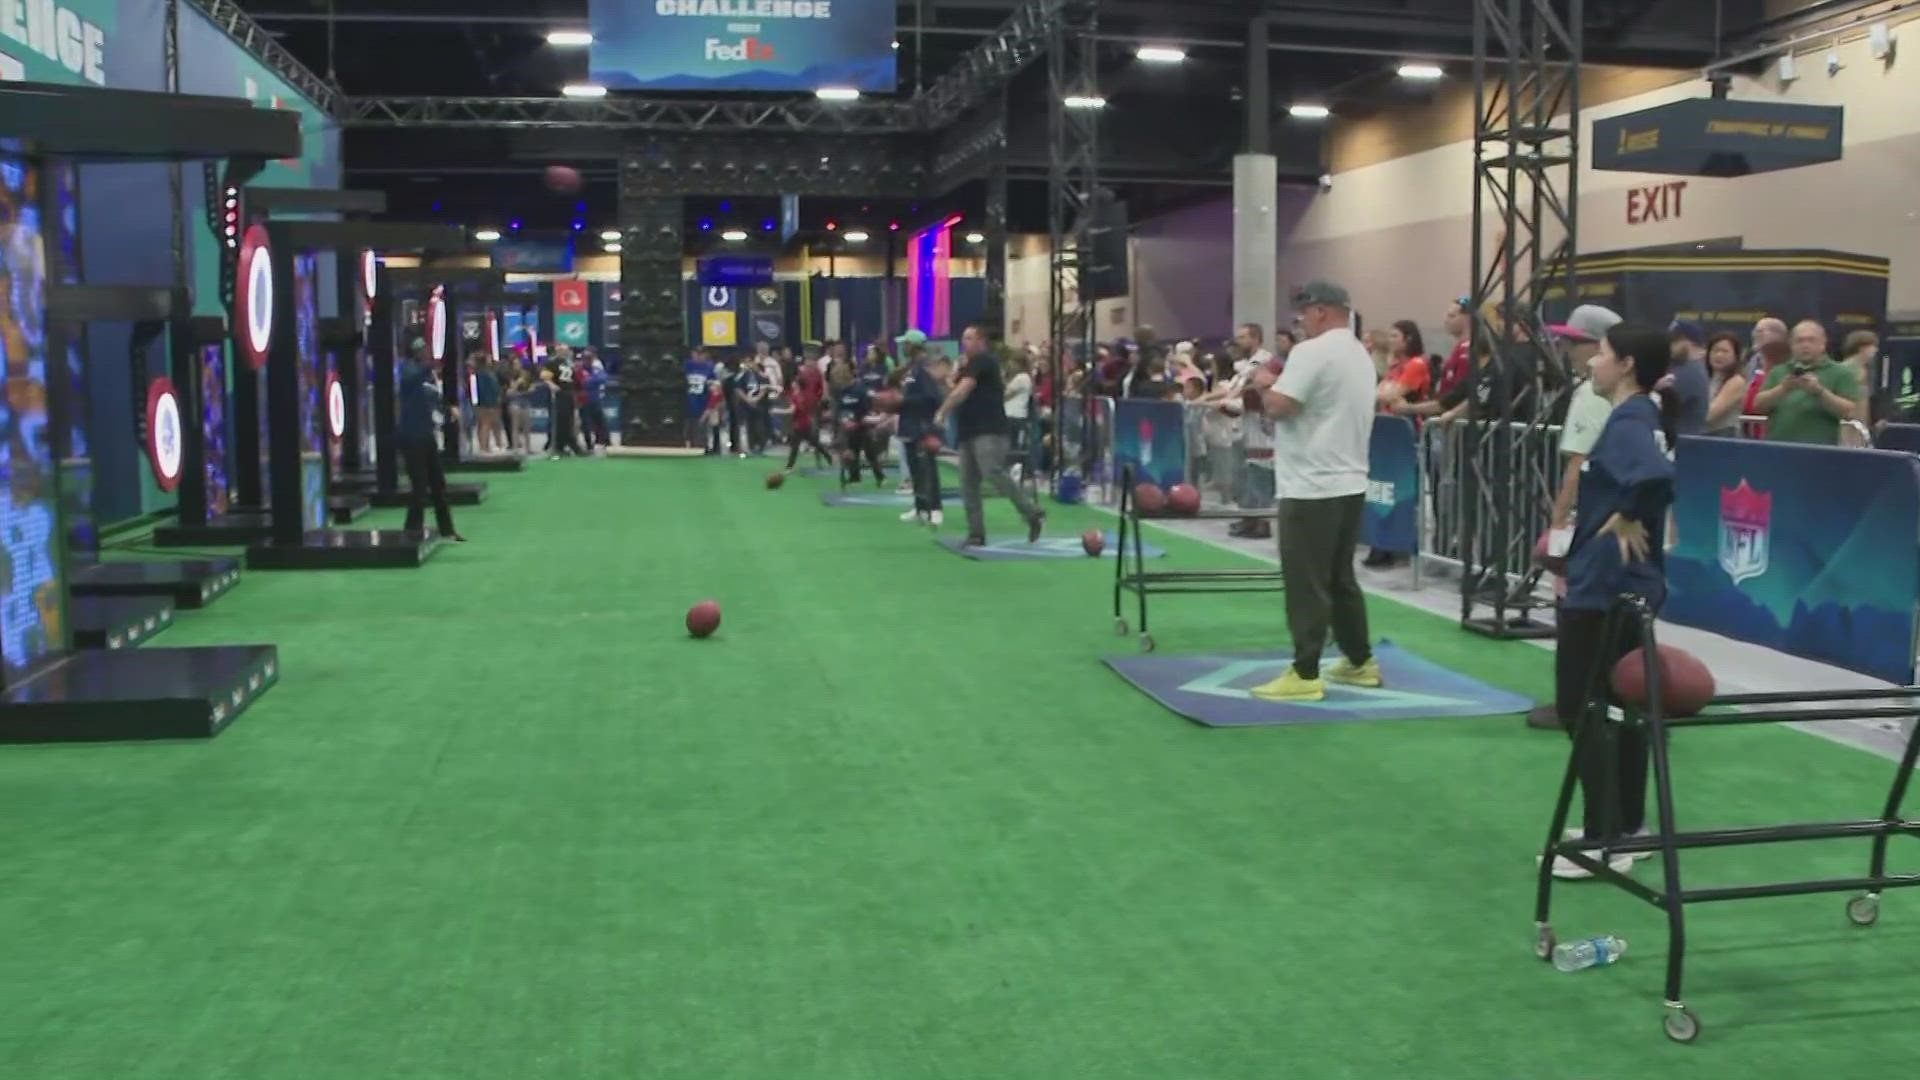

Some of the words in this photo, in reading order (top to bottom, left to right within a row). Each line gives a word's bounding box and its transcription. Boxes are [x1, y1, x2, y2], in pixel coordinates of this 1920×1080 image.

[656, 0, 831, 18] CHALLENGE
[705, 37, 774, 60] FedEx
[1626, 181, 1687, 224] EXIT
